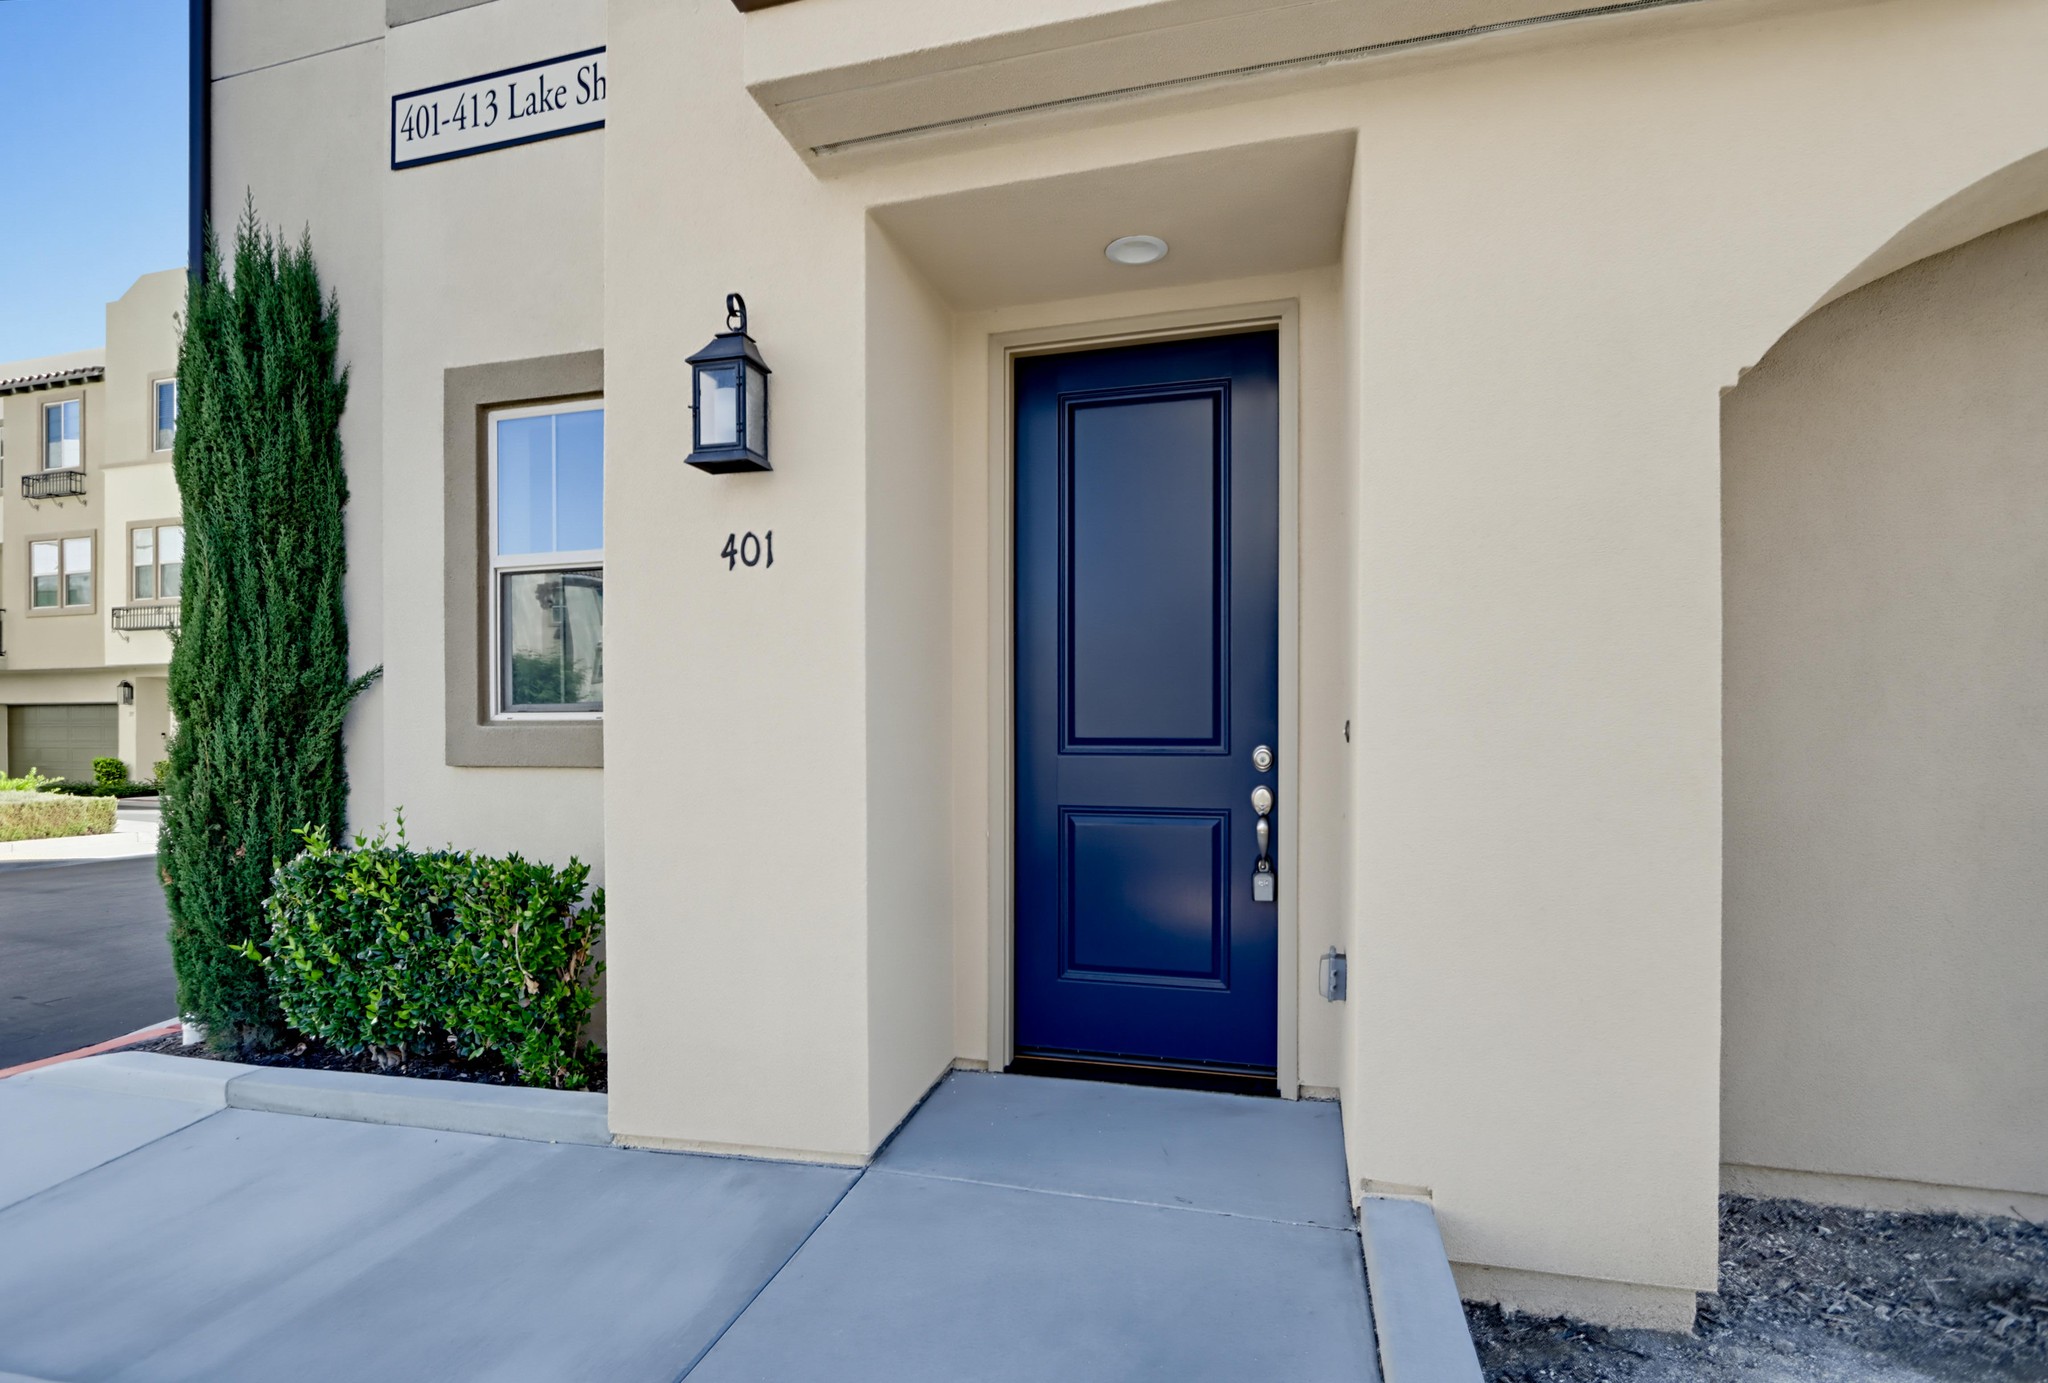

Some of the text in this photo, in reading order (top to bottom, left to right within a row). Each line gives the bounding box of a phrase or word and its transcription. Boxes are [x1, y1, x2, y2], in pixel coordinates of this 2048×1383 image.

[400, 61, 606, 142] 401-413 Lake Sh
[720, 530, 774, 571] 401
